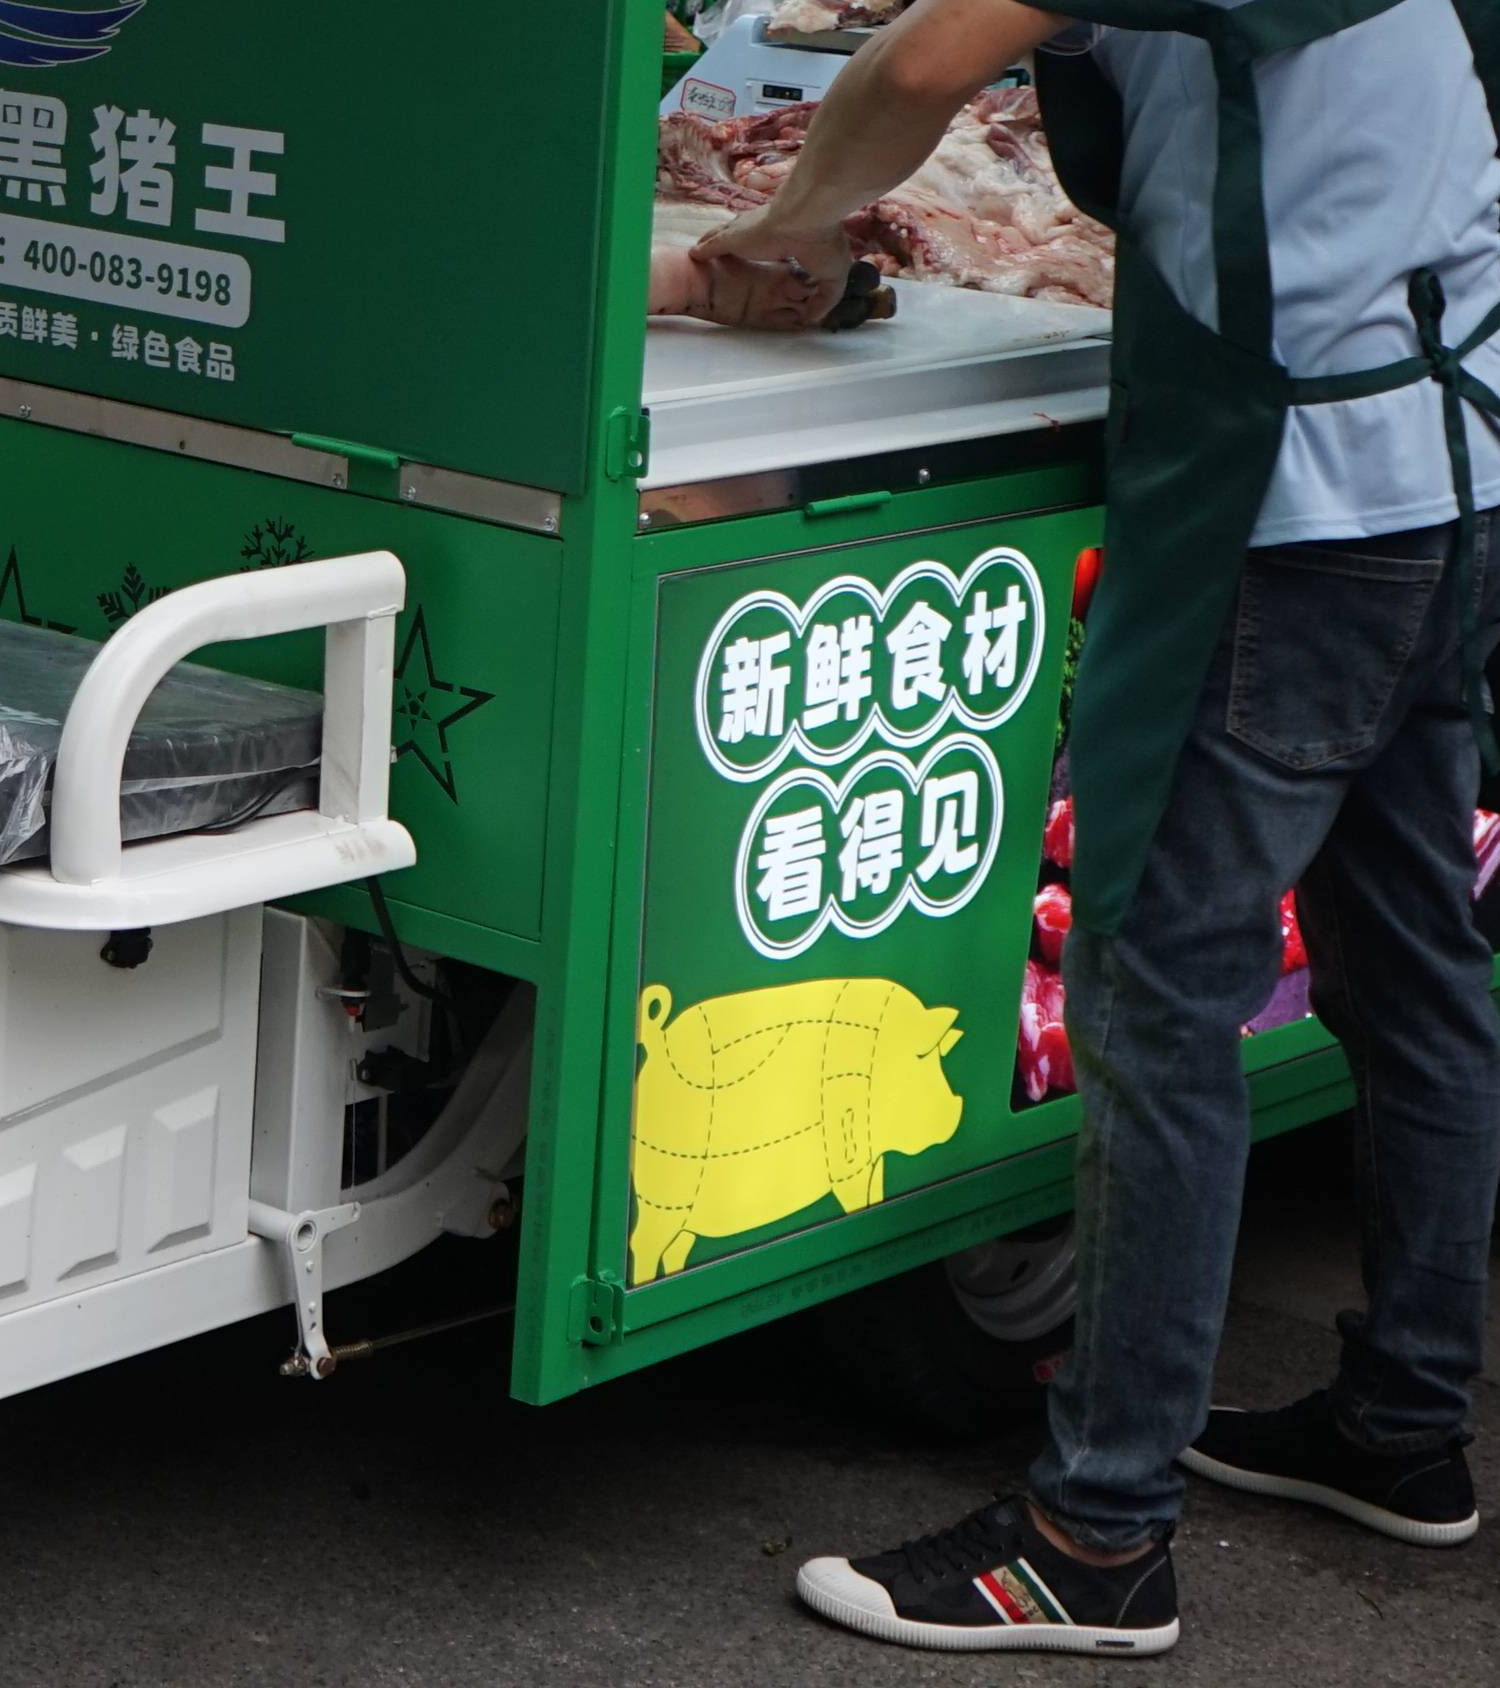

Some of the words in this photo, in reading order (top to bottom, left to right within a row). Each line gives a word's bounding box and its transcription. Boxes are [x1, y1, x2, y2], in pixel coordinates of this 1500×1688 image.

[715, 582, 1031, 748] 新鲜食材
[755, 769, 983, 918] 看得见
